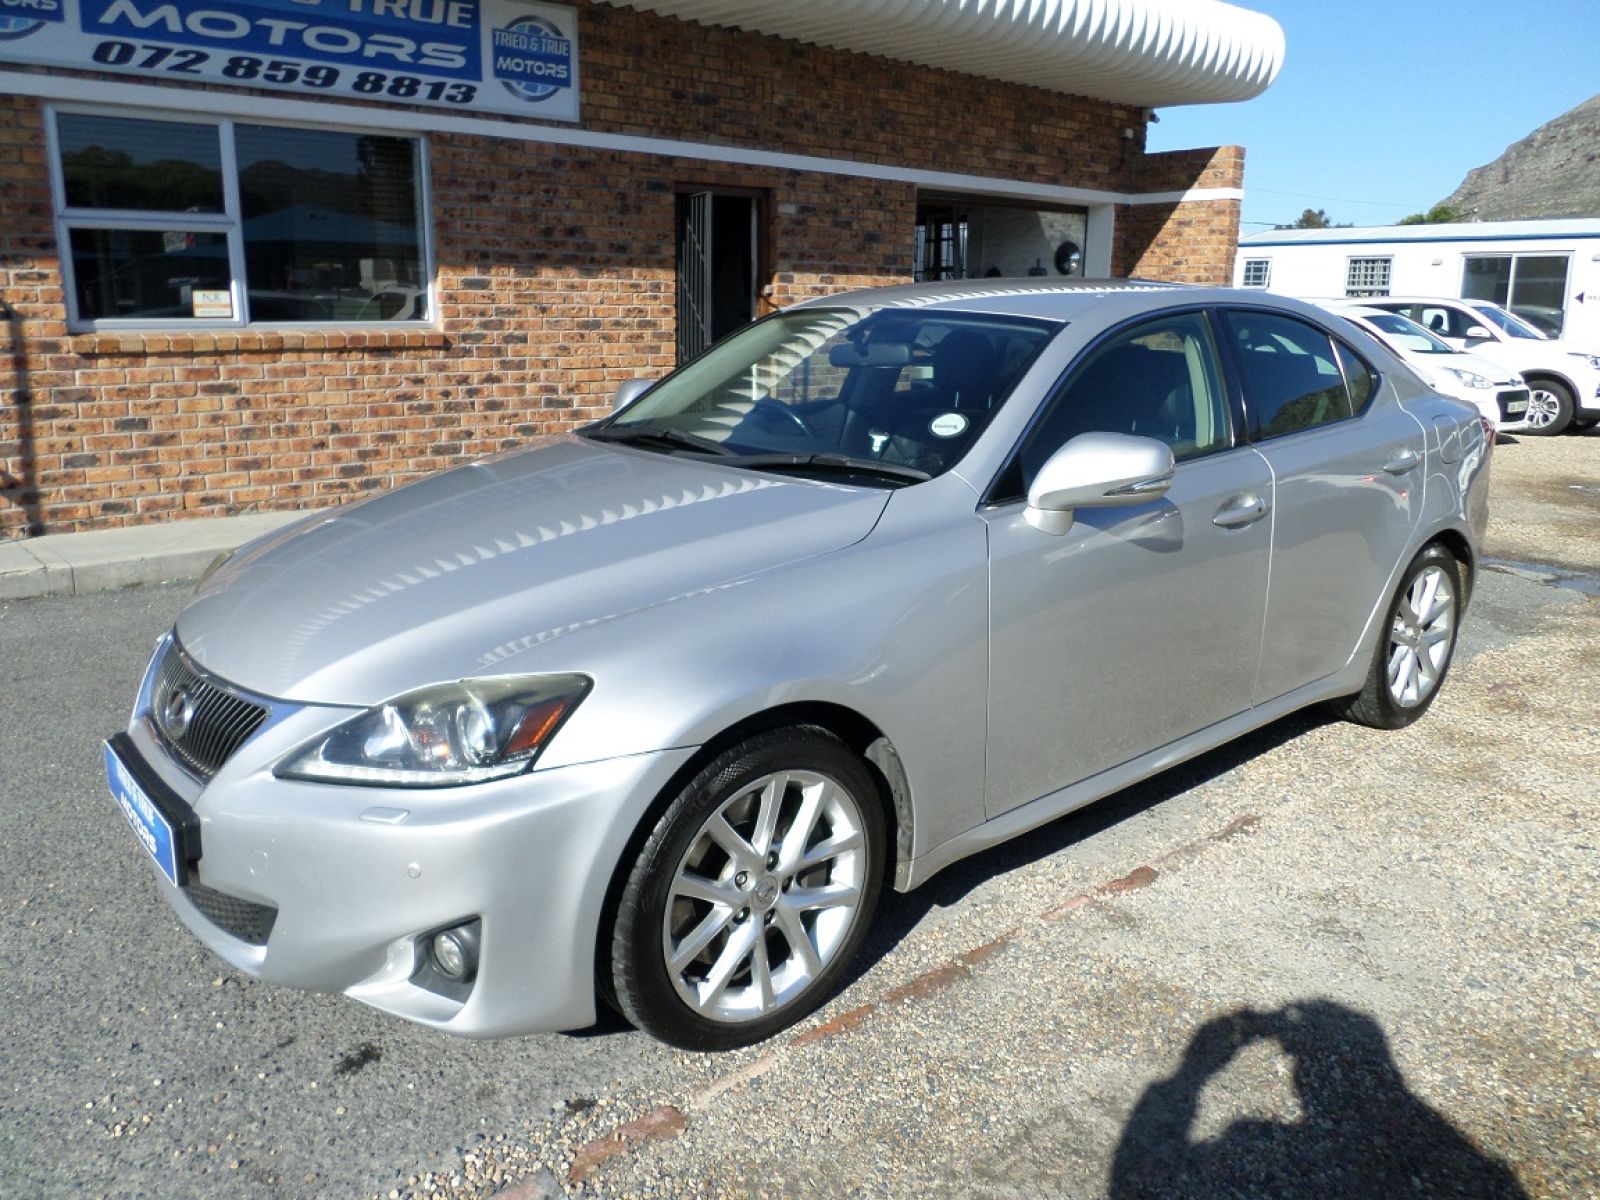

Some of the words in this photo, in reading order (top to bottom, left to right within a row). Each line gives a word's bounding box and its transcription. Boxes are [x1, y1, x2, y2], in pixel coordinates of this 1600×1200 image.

[97, 0, 468, 69] MOTORS
[495, 31, 527, 49] TRIED
[530, 36, 538, 51] &
[541, 38, 570, 56] TRUE
[92, 41, 210, 74] 072
[222, 56, 340, 89] 859
[352, 71, 478, 104] 8813
[496, 56, 569, 78] MOTORS
[120, 791, 158, 854] MOTORS
